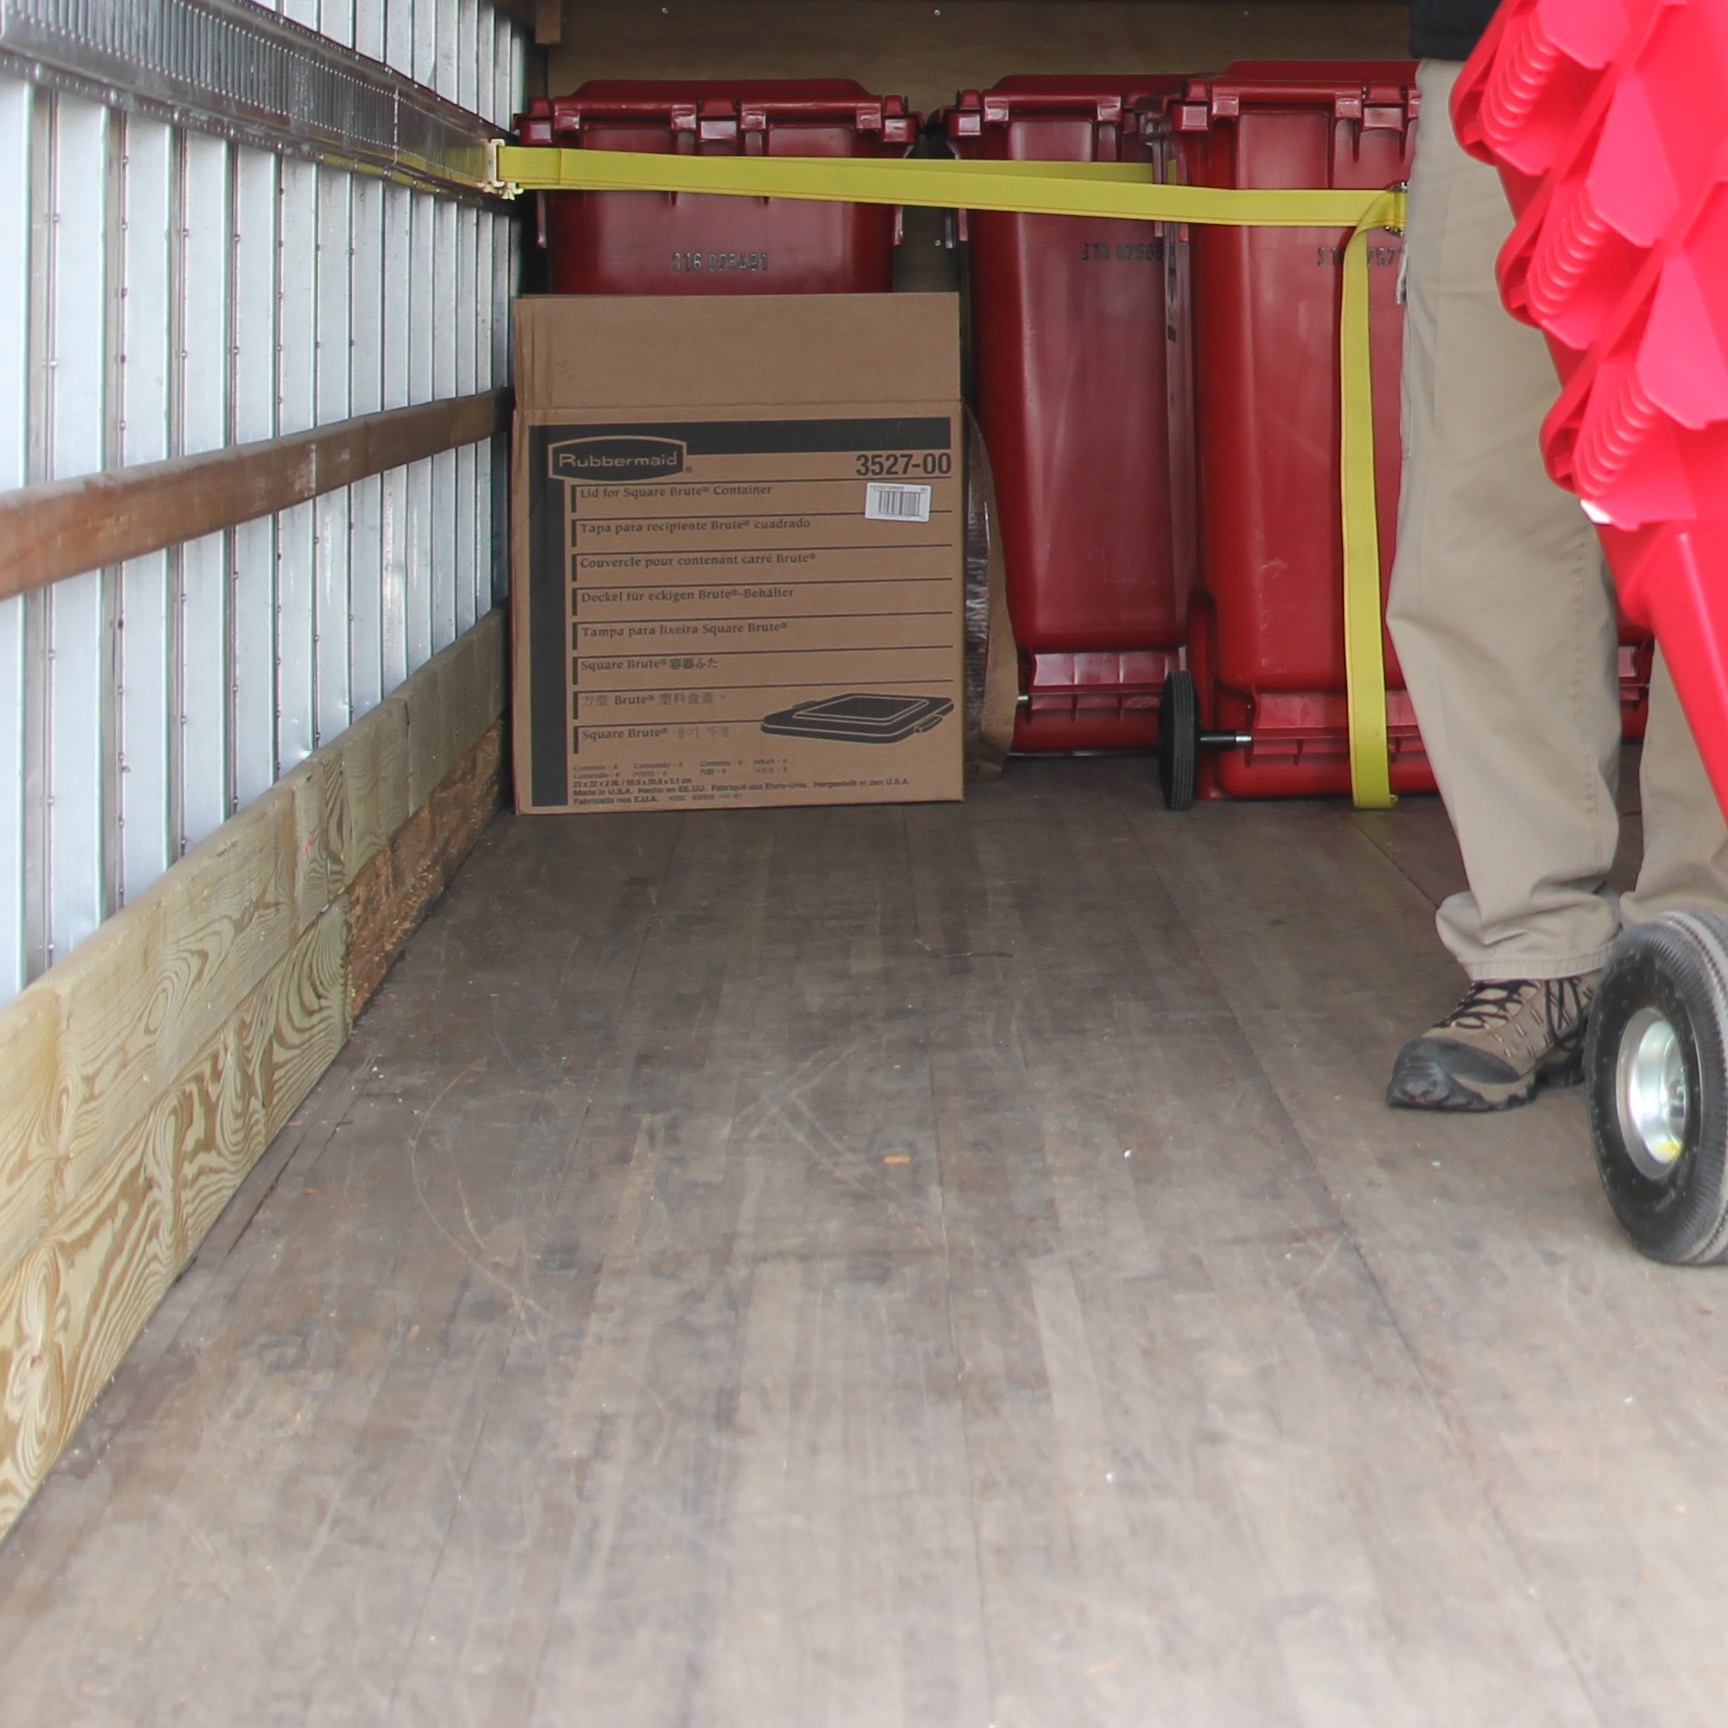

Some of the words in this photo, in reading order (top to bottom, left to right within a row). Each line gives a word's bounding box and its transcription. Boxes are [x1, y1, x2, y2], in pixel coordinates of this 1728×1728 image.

[558, 451, 677, 468] Rubbermaid
[856, 453, 952, 475] 3527-00
[580, 488, 599, 499] Lid
[604, 488, 620, 498] for
[624, 487, 665, 500] Square
[713, 486, 772, 496] Container
[580, 523, 611, 535] Tapa
[615, 524, 642, 535] para
[647, 521, 707, 534] recipiente
[754, 519, 811, 529] cuadrado
[580, 557, 641, 569] Couvercle
[645, 557, 673, 569] pour
[677, 555, 738, 566] contenant
[582, 592, 623, 603] Deckel
[649, 590, 694, 603] eckigen
[582, 627, 624, 638] Tampa
[629, 626, 656, 638] para
[660, 624, 698, 635] lixeira
[702, 624, 744, 636] Square
[581, 660, 623, 672] Square
[583, 730, 624, 742] Square
